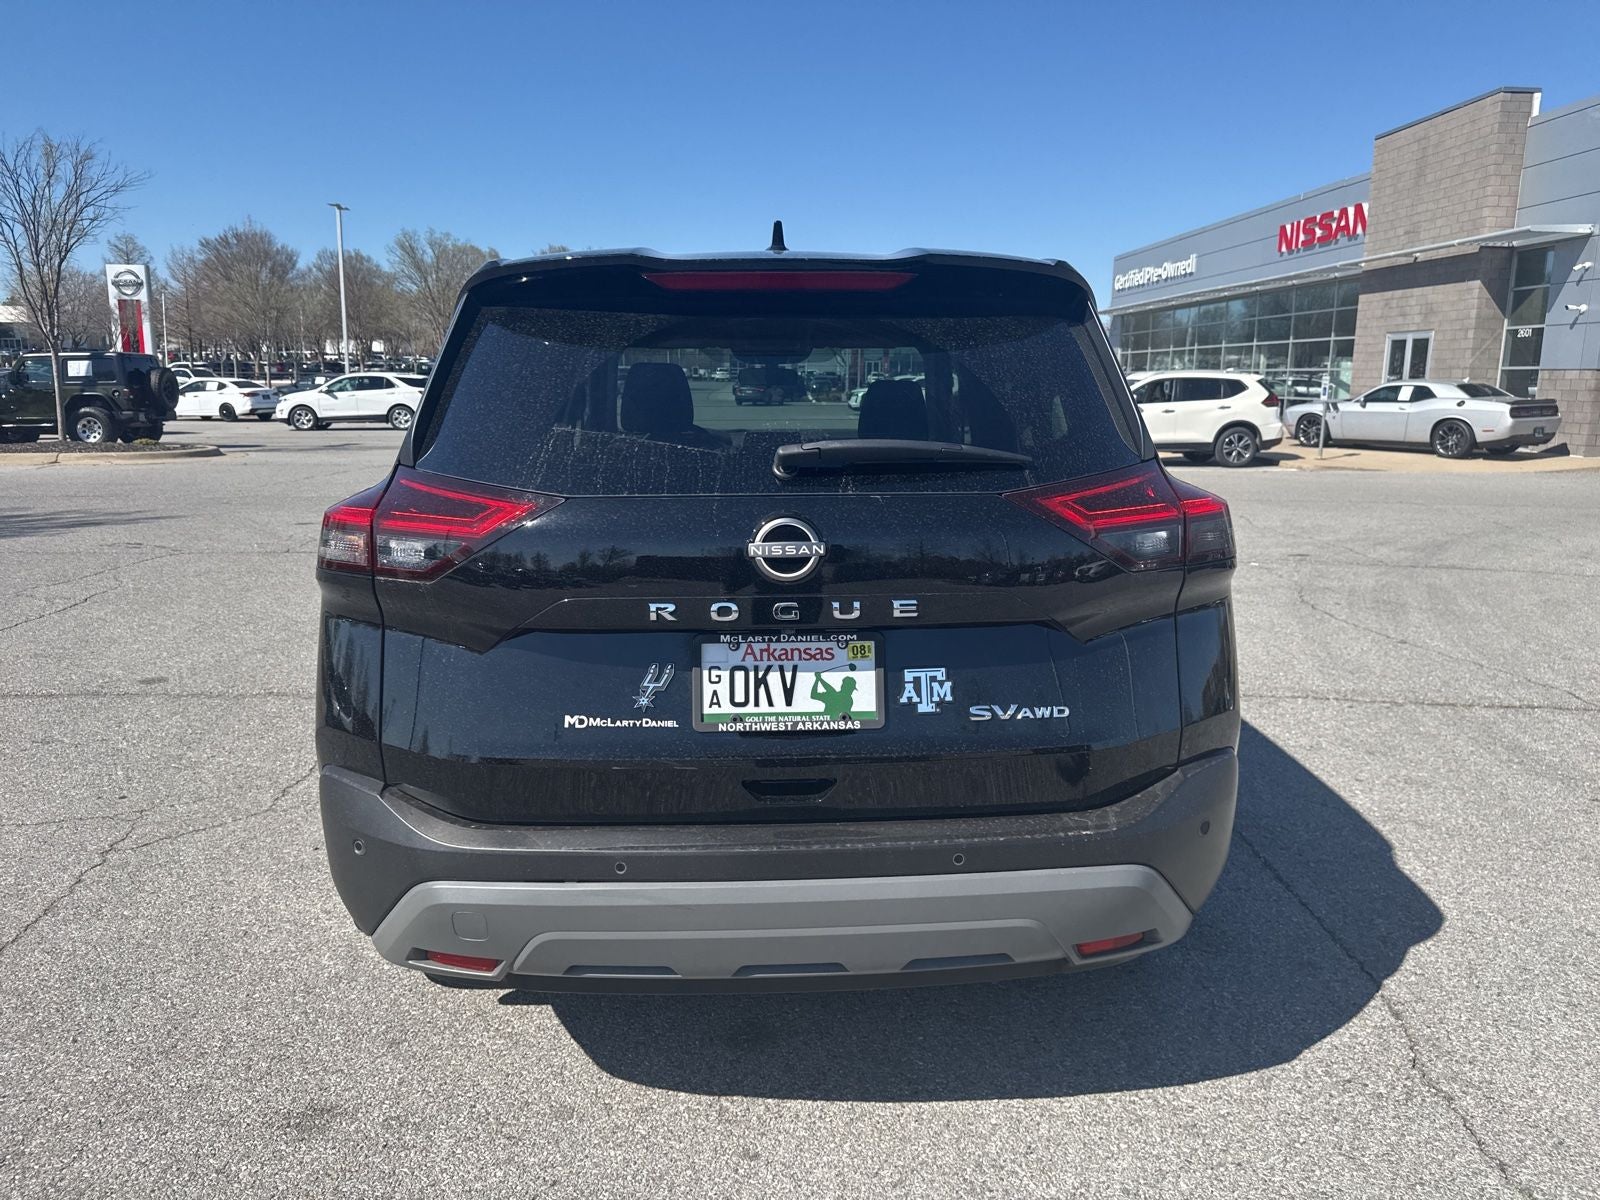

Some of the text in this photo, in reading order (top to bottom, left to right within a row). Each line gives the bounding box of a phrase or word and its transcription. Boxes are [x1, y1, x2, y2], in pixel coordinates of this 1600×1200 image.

[1277, 202, 1368, 253] NISSAN
[1114, 254, 1197, 290] Certified Pre-Owned
[750, 544, 824, 556] NISSAN
[648, 599, 919, 622] ROGUE
[741, 643, 836, 663] Arkansas
[852, 644, 866, 656] 08
[718, 720, 861, 732] NORTHWEST ARKANSAS
